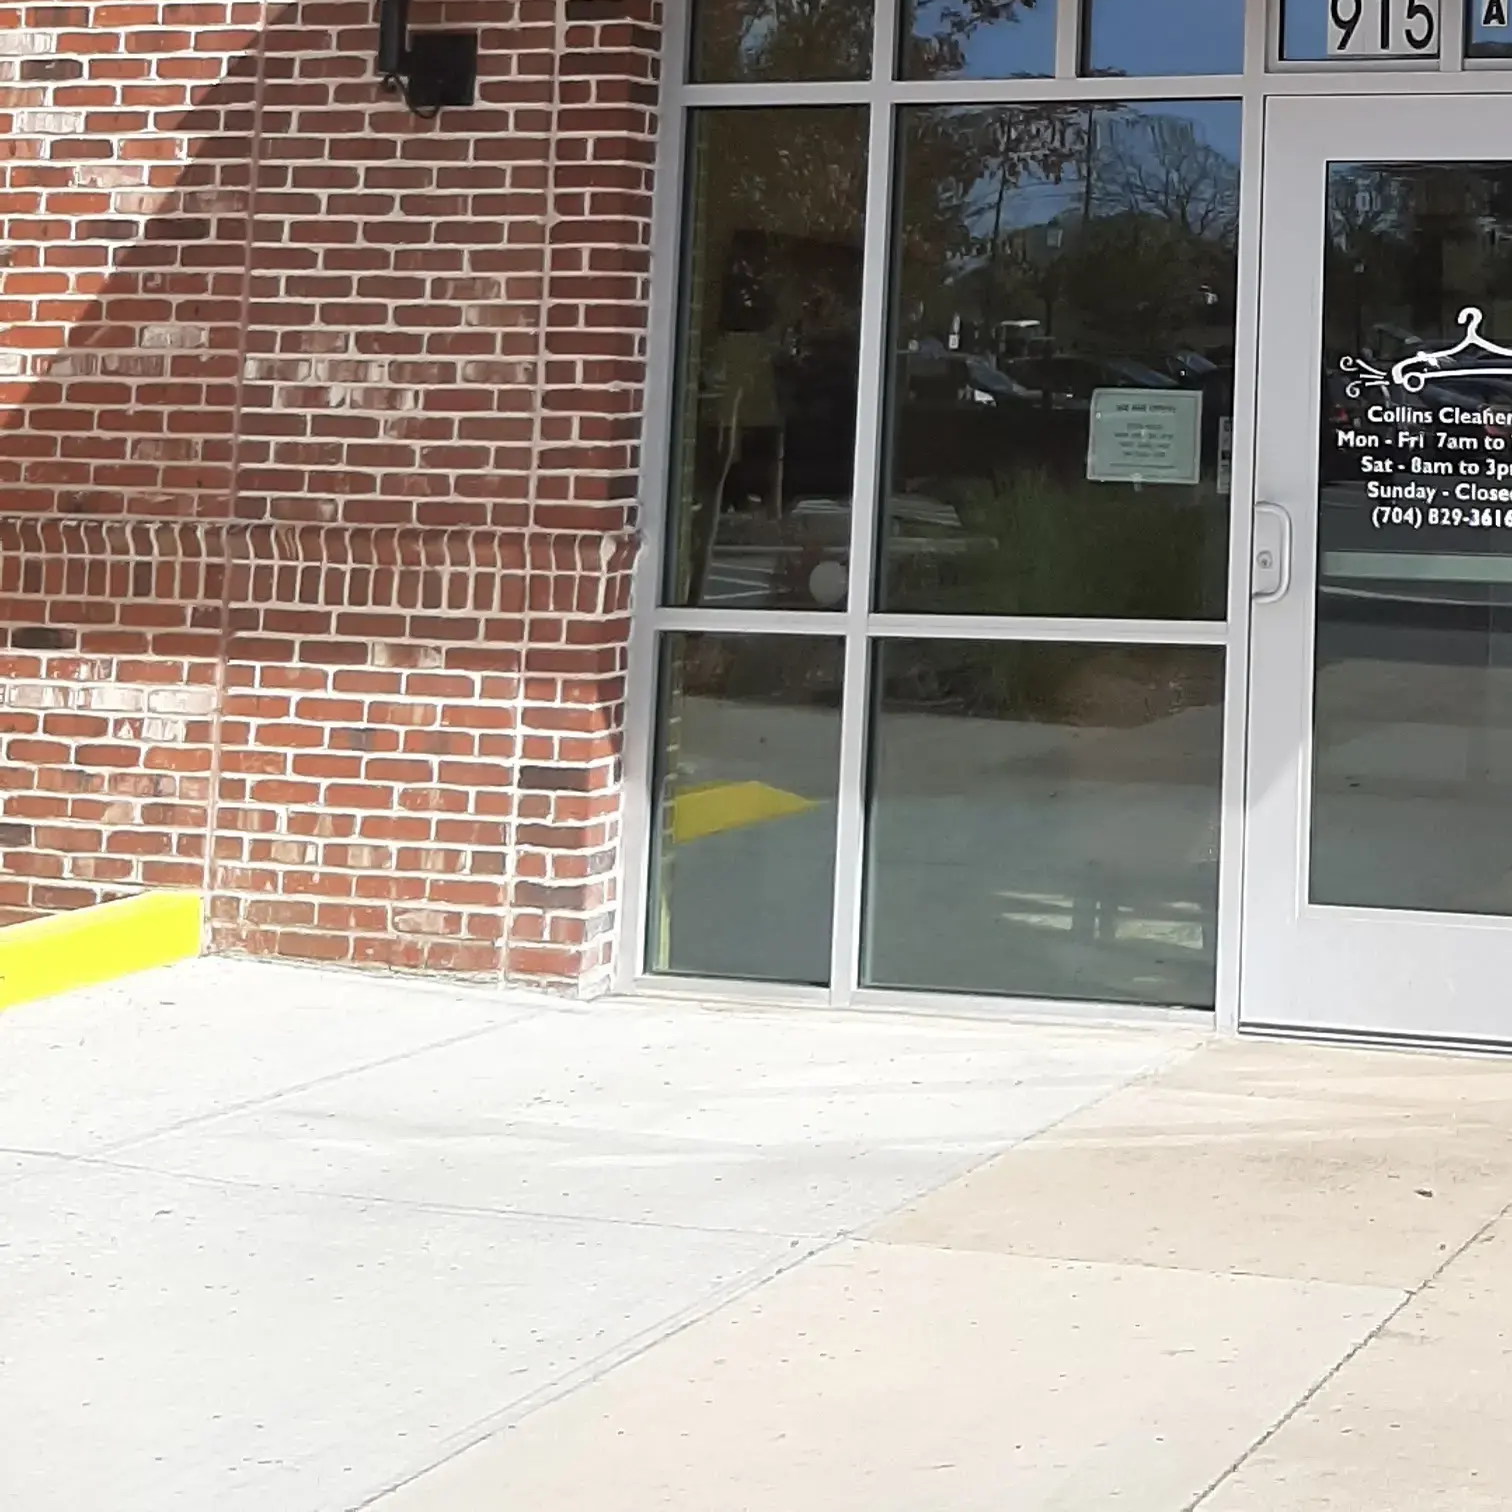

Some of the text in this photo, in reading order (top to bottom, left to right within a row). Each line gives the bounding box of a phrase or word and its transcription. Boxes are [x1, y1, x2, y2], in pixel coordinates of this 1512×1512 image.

[1367, 406, 1433, 424] Collins
[1337, 430, 1379, 448] Mon
[1398, 432, 1424, 449] Fri
[1436, 432, 1478, 450] 7am
[1484, 434, 1505, 451] to
[1361, 457, 1393, 474] Sat
[1411, 457, 1453, 475] 8am
[1459, 460, 1480, 476] to
[1367, 481, 1437, 504] Sunday
[1372, 506, 1422, 528] (704)
